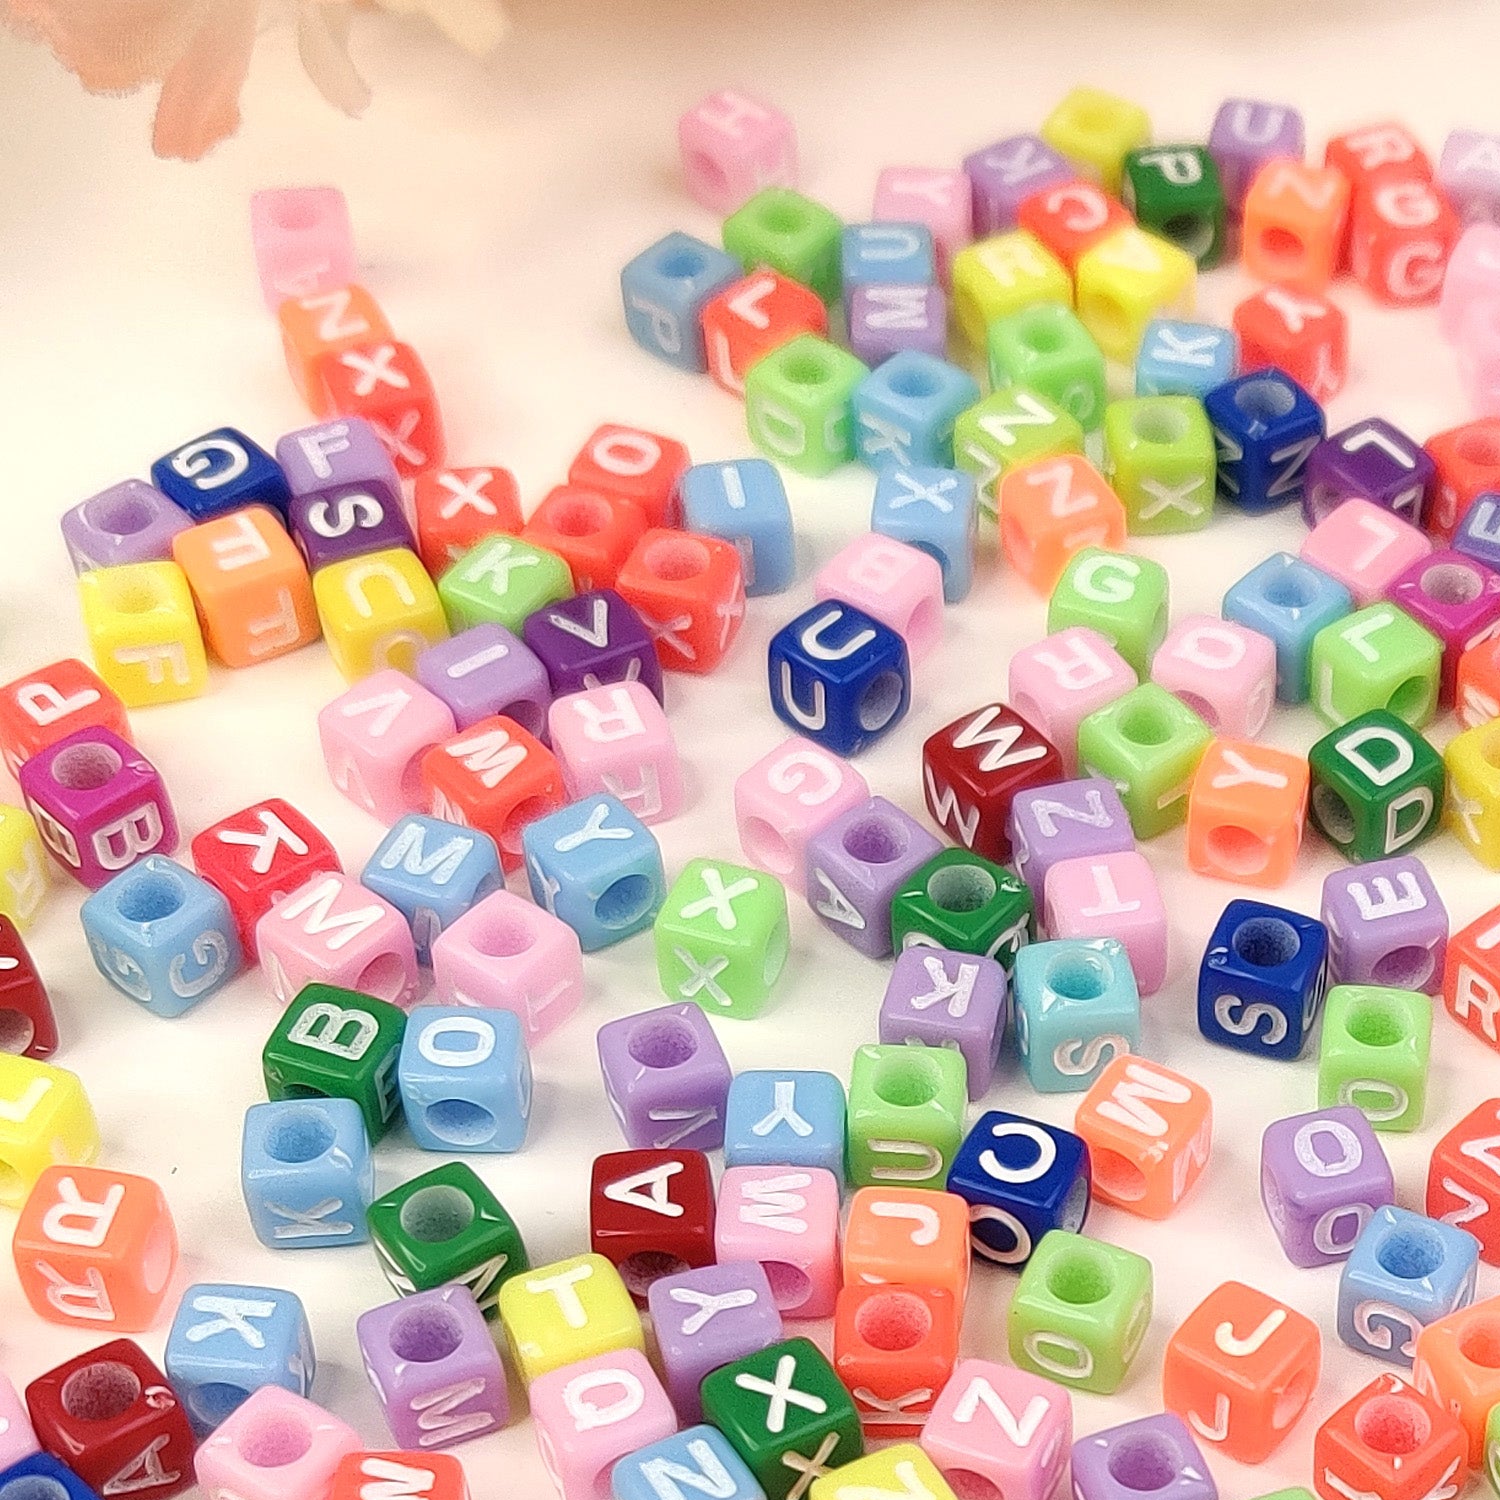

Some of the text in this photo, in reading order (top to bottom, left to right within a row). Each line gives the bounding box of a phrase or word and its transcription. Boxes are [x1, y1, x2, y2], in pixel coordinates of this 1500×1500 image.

[1046, 188, 1108, 231] C
[728, 278, 778, 330] L
[342, 345, 409, 395] X
[1158, 328, 1219, 366] K
[172, 440, 249, 489] G
[299, 425, 351, 478] F
[1342, 430, 1415, 469] L
[308, 495, 384, 538] S
[436, 473, 498, 518] X
[465, 542, 539, 593] K
[549, 599, 608, 648] V
[802, 610, 876, 660] U
[17, 682, 100, 725] P
[1335, 726, 1414, 786] D
[94, 802, 164, 870] B
[219, 811, 309, 874] K
[555, 804, 633, 852] Y
[1347, 871, 1428, 921] E
[910, 956, 979, 1017] K
[287, 1002, 380, 1061] B
[417, 1016, 496, 1067] O
[1214, 996, 1288, 1045] S
[1053, 1036, 1131, 1075] S
[752, 1081, 814, 1136] Y
[979, 1122, 1057, 1183] C
[1294, 1120, 1364, 1177] O
[42, 1177, 125, 1246] R
[604, 1161, 684, 1217] A
[869, 1201, 941, 1245] J
[186, 1297, 277, 1349] K
[669, 1288, 757, 1336] Y
[1214, 1310, 1287, 1356] J
[561, 1369, 646, 1432] Q
[734, 1355, 827, 1432] X
